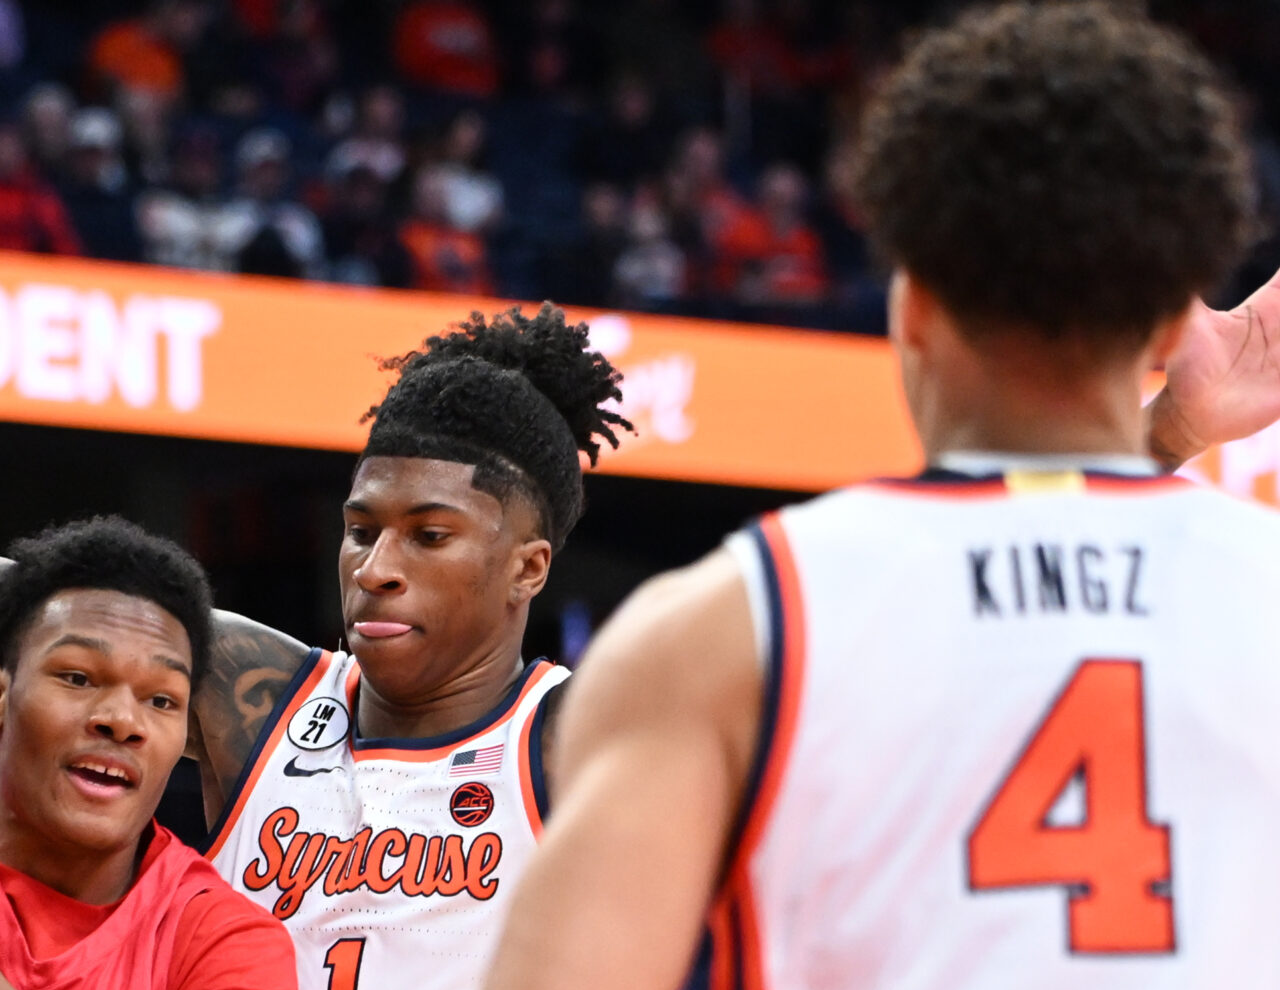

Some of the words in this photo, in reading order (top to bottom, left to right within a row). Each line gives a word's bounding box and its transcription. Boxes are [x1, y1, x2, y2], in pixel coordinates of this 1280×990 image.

[967, 543, 1150, 618] KINGZ
[312, 703, 336, 722] LM
[300, 720, 327, 744] 21
[458, 796, 490, 807] ACC
[964, 657, 1178, 956] 4
